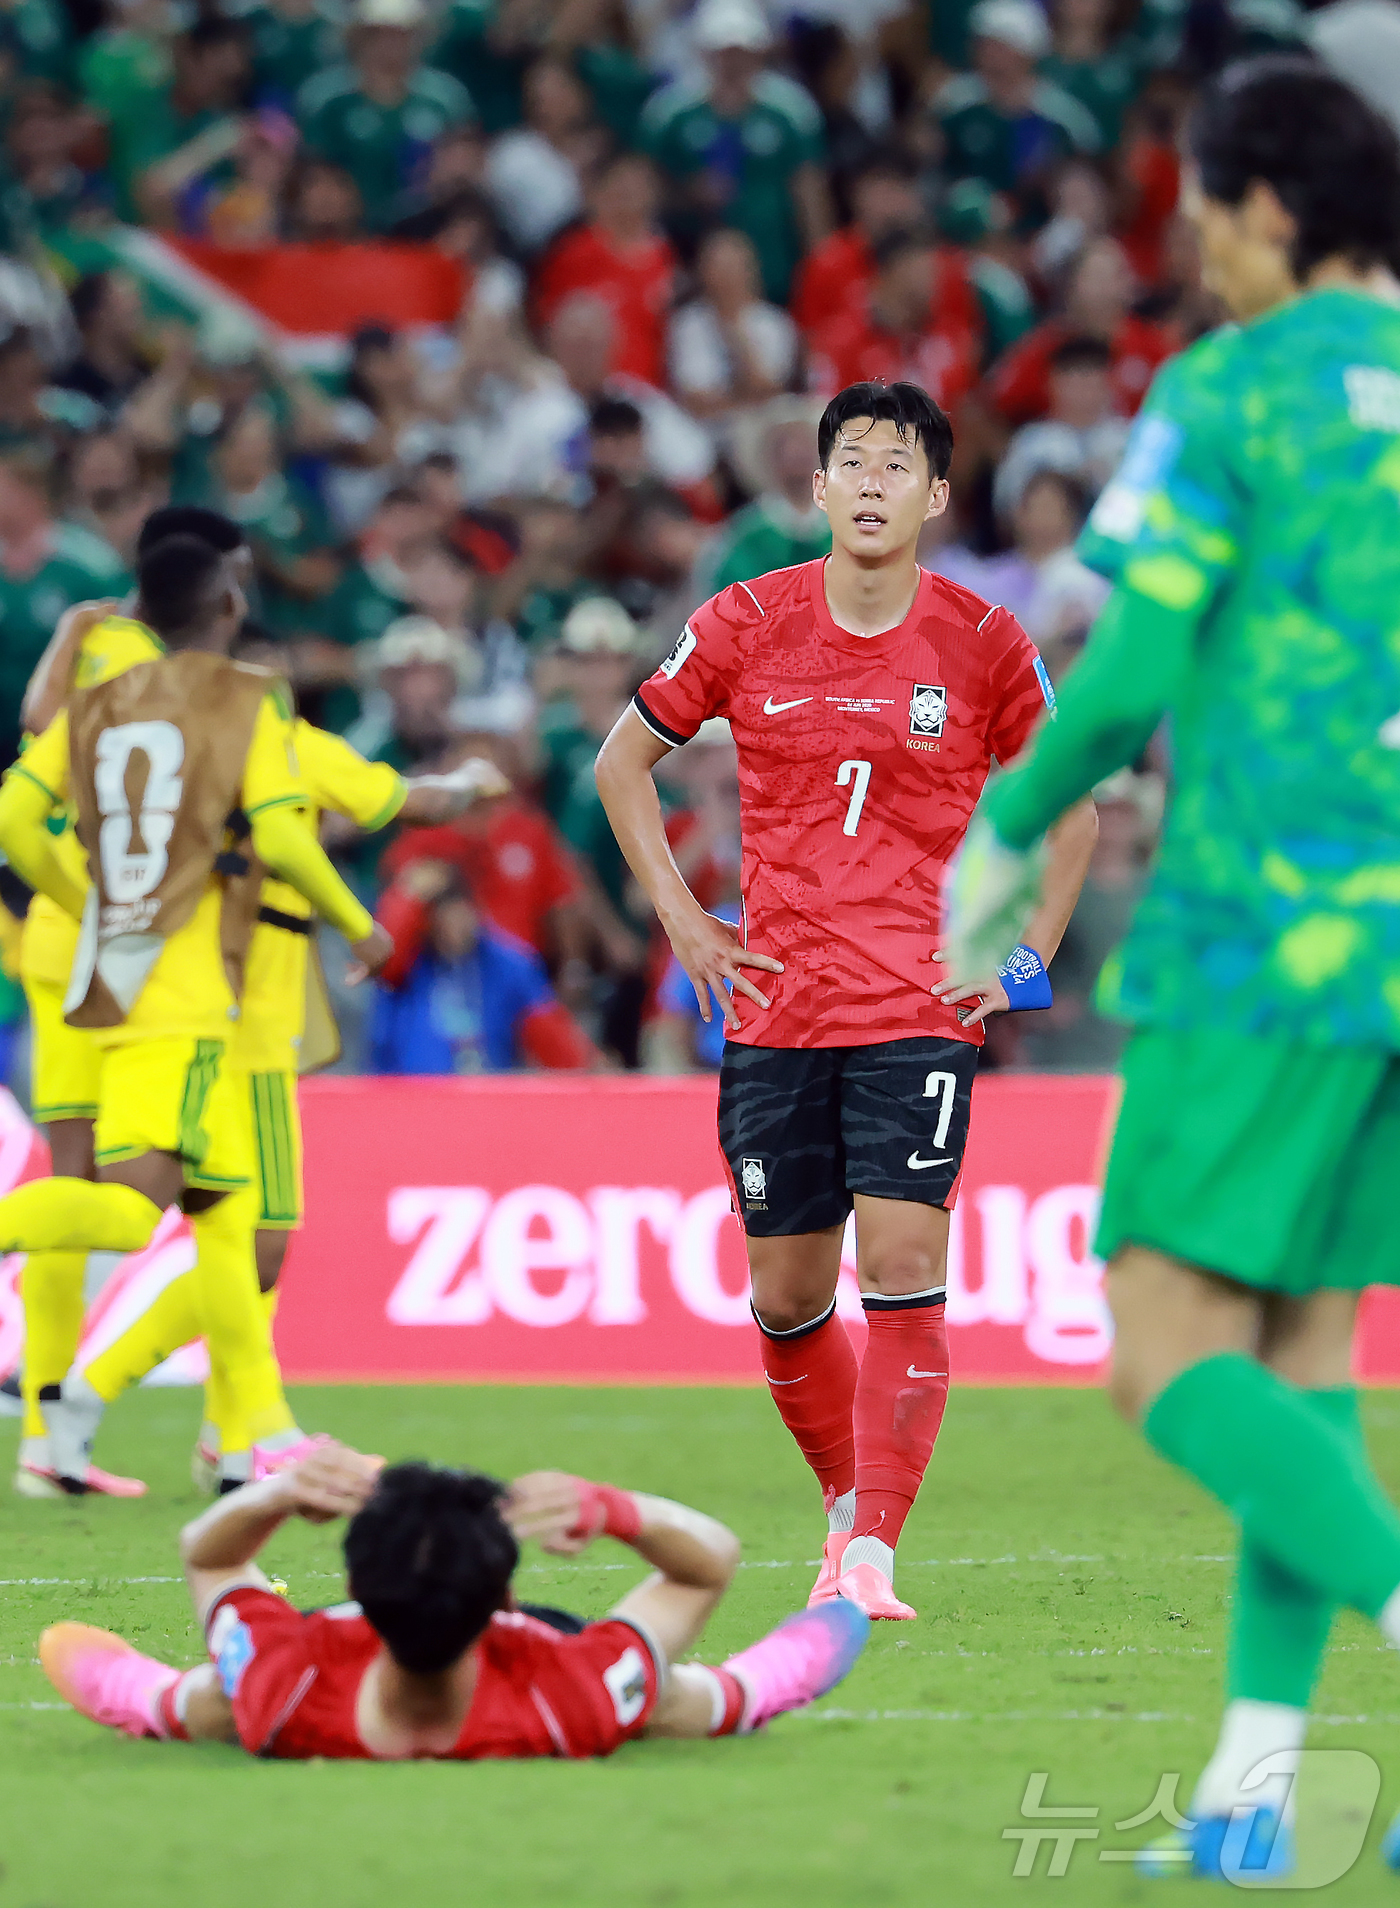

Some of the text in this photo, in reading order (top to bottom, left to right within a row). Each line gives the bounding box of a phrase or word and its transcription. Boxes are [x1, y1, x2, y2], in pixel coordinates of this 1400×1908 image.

[906, 739, 940, 753] KOREA
[834, 759, 872, 837] 7
[1007, 955, 1035, 979] UNTES
[1013, 947, 1042, 975] FOOTBALL
[922, 1071, 957, 1149] 7
[387, 1184, 753, 1327] zero
